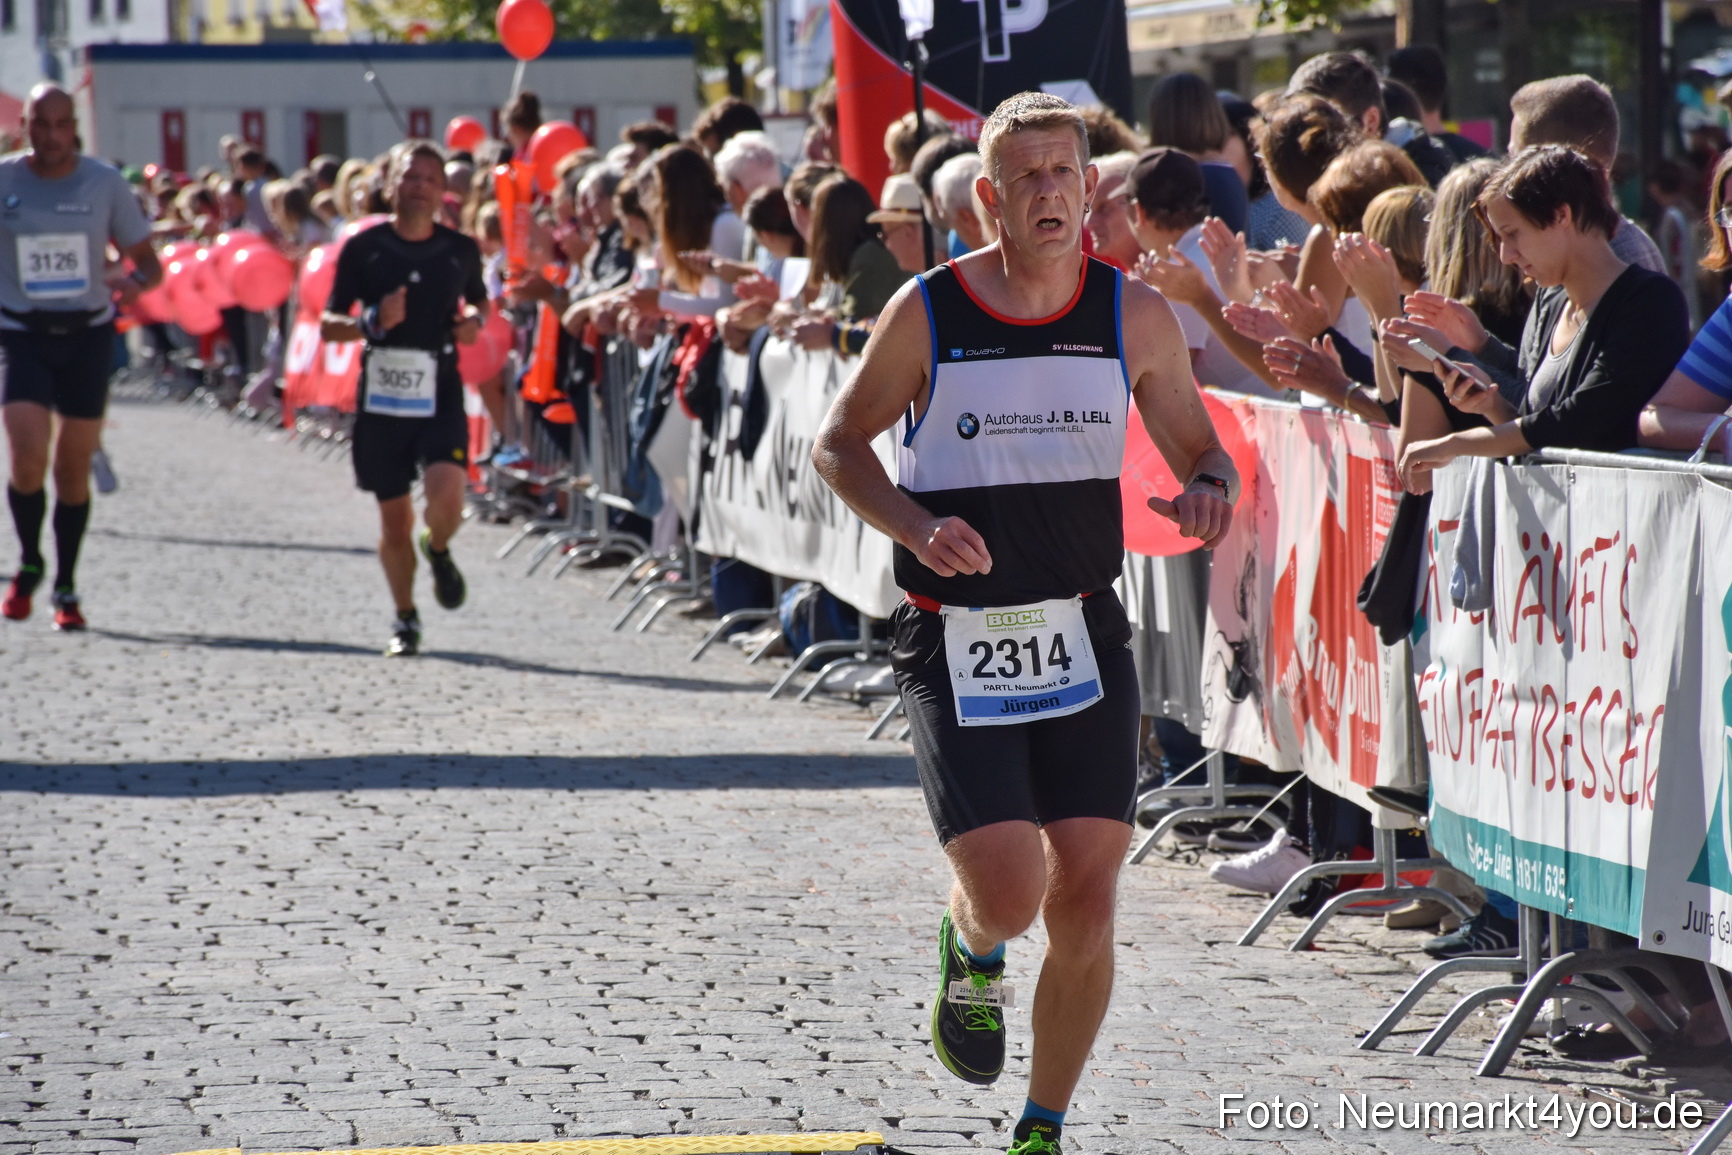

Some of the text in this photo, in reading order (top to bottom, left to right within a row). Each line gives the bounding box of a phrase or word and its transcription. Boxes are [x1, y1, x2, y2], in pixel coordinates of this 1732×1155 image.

[30, 250, 78, 273] 3126
[1063, 345, 1103, 353] ILLSCHWANG
[377, 367, 424, 389] 3057
[984, 410, 1112, 426] Autohaus J. B. LELL
[985, 427, 1028, 436] Leidenschaft
[1029, 426, 1054, 436] beginnt
[1067, 425, 1085, 433] LELL
[986, 609, 1046, 627] BOCK
[968, 632, 1073, 679] 2314
[957, 671, 964, 679] A
[983, 681, 1058, 692] PARTL Neumarkt
[1000, 697, 1061, 714] Jürgen
[1682, 900, 1714, 937] Jura
